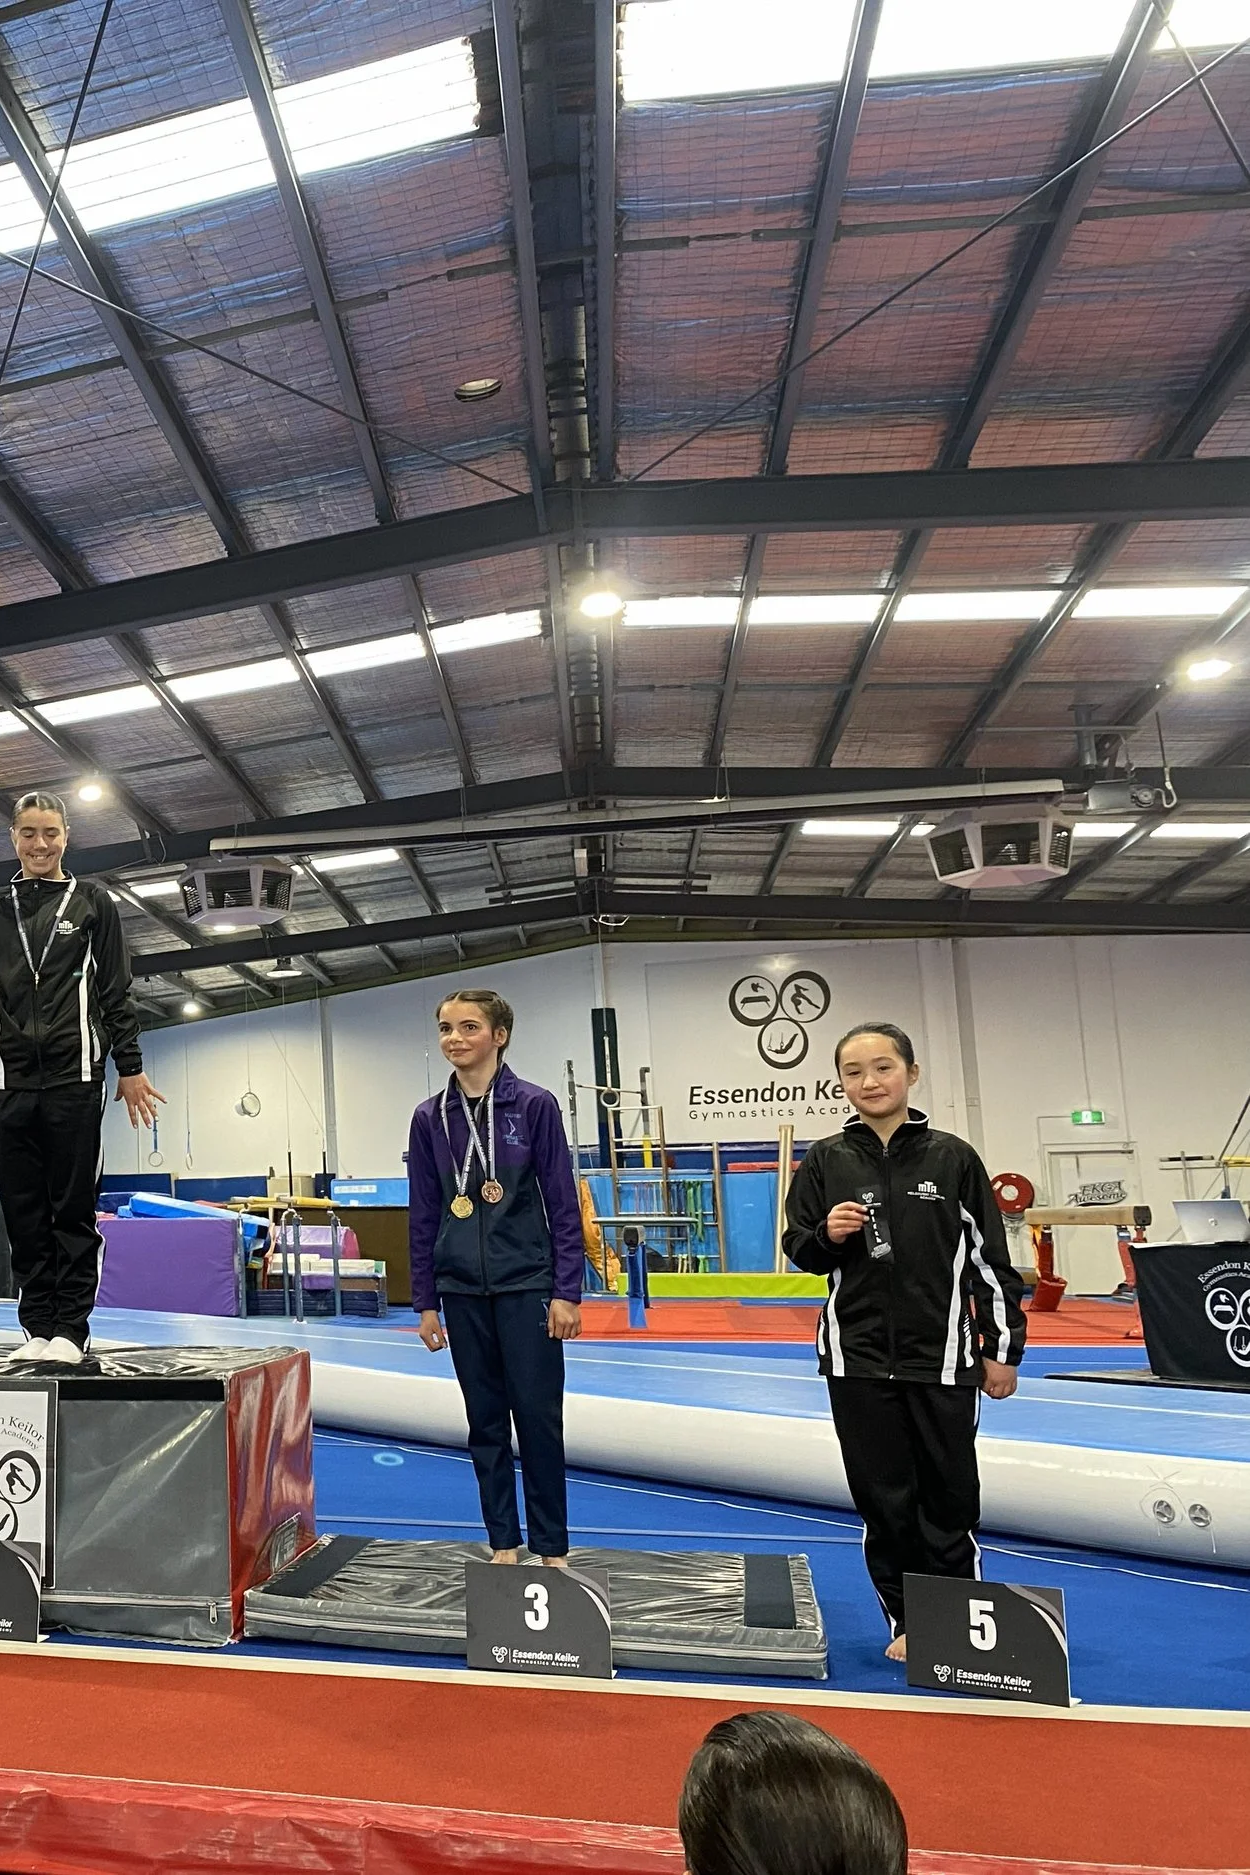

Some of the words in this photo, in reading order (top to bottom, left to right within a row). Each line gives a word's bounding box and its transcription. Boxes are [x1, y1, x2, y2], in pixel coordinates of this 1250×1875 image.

[689, 1081, 806, 1105] Essendon
[689, 1107, 795, 1121] Gymnastics
[805, 1104, 859, 1116] Acad
[1197, 1260, 1241, 1284] Essendon
[0, 1428, 39, 1451] Academy
[9, 1415, 45, 1442] Keilor
[524, 1583, 549, 1631] 3
[969, 1599, 997, 1651] 5
[512, 1649, 553, 1661] Essendon
[554, 1652, 580, 1663] Keilor
[956, 1669, 1002, 1683] Essendon
[1003, 1674, 1031, 1687] Keilor
